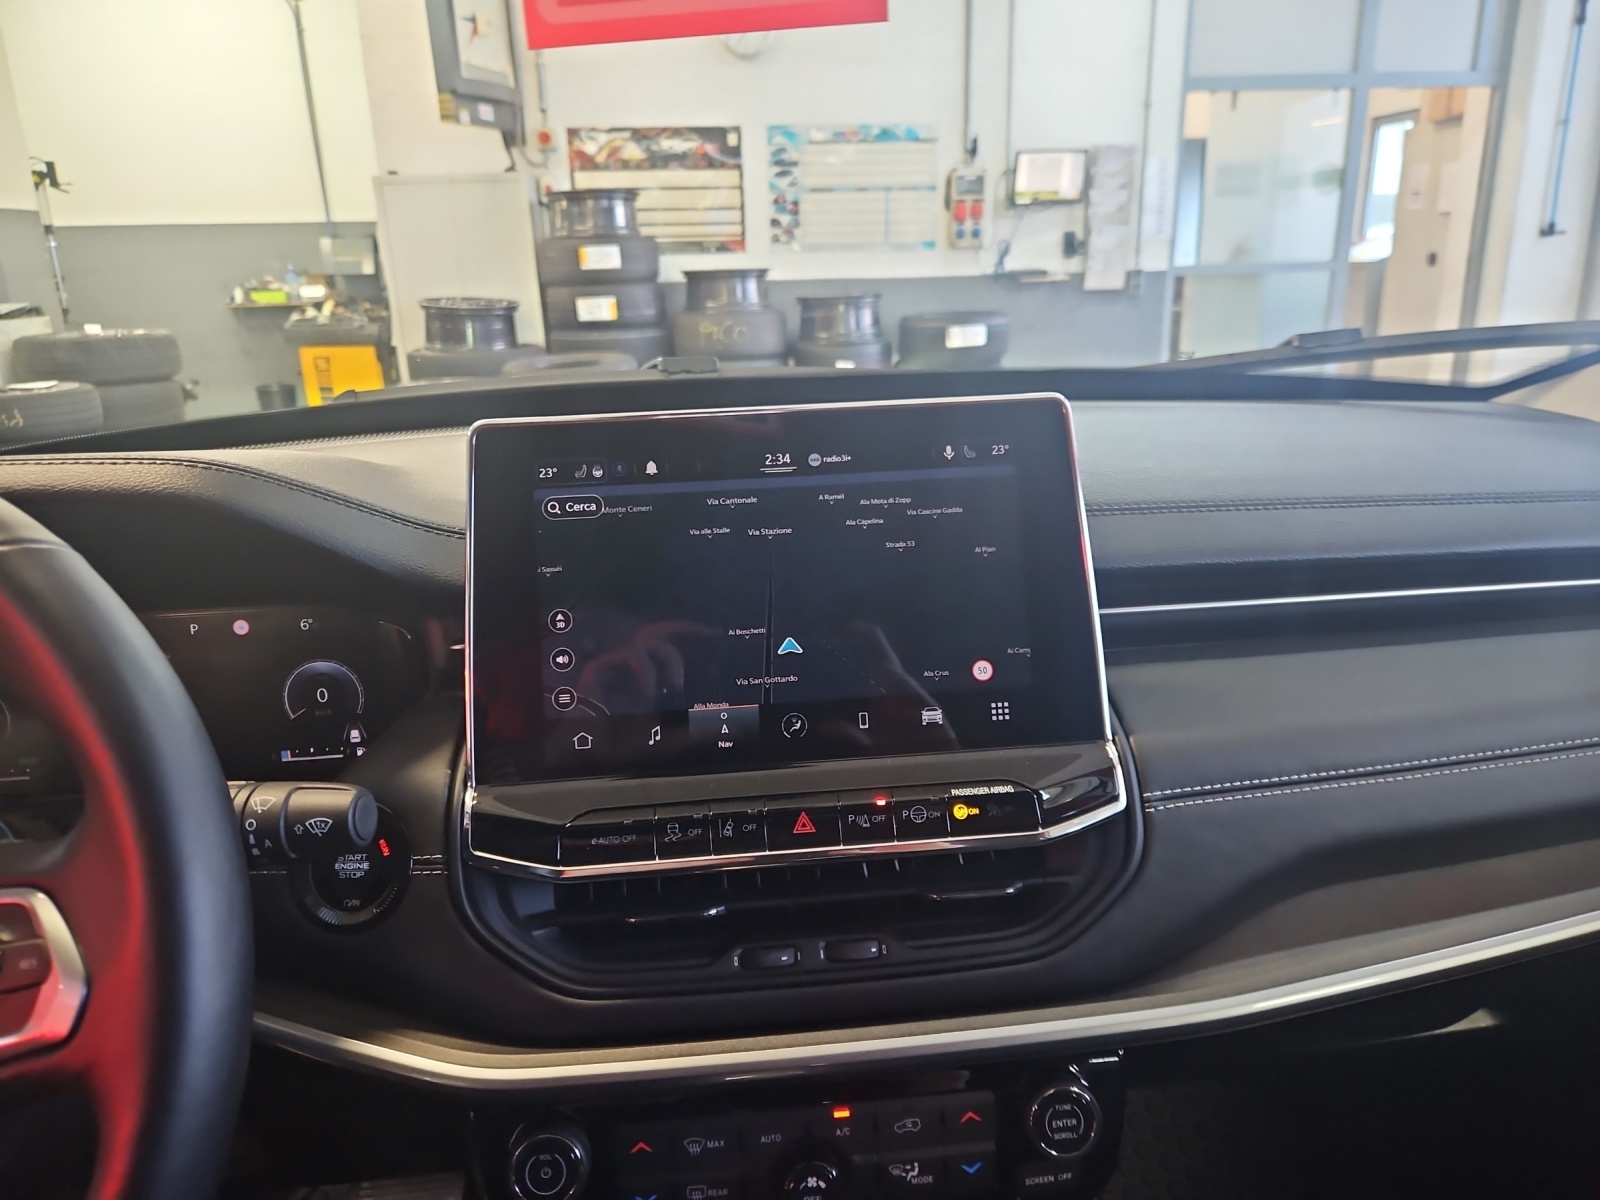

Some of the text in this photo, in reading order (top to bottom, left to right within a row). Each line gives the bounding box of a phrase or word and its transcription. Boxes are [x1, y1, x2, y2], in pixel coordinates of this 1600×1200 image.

[991, 444, 1009, 455] 23°
[764, 453, 791, 465] 2:34
[538, 467, 558, 478] 23°
[706, 496, 758, 506] Via Cantonale
[565, 501, 597, 512] Cerca
[628, 504, 653, 513] Ceneri
[906, 508, 916, 516] Via
[942, 506, 963, 514] Gadda
[748, 526, 792, 536] Via Stazione
[190, 624, 198, 634] P
[300, 618, 313, 630] 6°
[736, 627, 766, 636] Boschetti
[978, 666, 988, 675] 50
[736, 678, 748, 686] Via
[764, 675, 798, 684] Gottardo
[316, 688, 328, 702] 0
[718, 740, 734, 748] Nav
[951, 785, 1014, 796] PASSENGER AIRBAG
[848, 814, 886, 824] P OFF
[903, 810, 940, 820] P ON
[688, 828, 702, 837] OFF
[742, 824, 757, 832] OFF
[622, 834, 637, 843] OFF
[378, 838, 390, 856] RUN
[1052, 1118, 1077, 1128] ENTER
[836, 1127, 850, 1137] A/C
[1053, 1132, 1078, 1141] SCROLL
[707, 1139, 725, 1148] MAX
[760, 1134, 782, 1144] AUTO
[911, 1175, 934, 1184] MODE
[1025, 1172, 1073, 1186] SCREEN OFF
[708, 1188, 728, 1197] REAR
